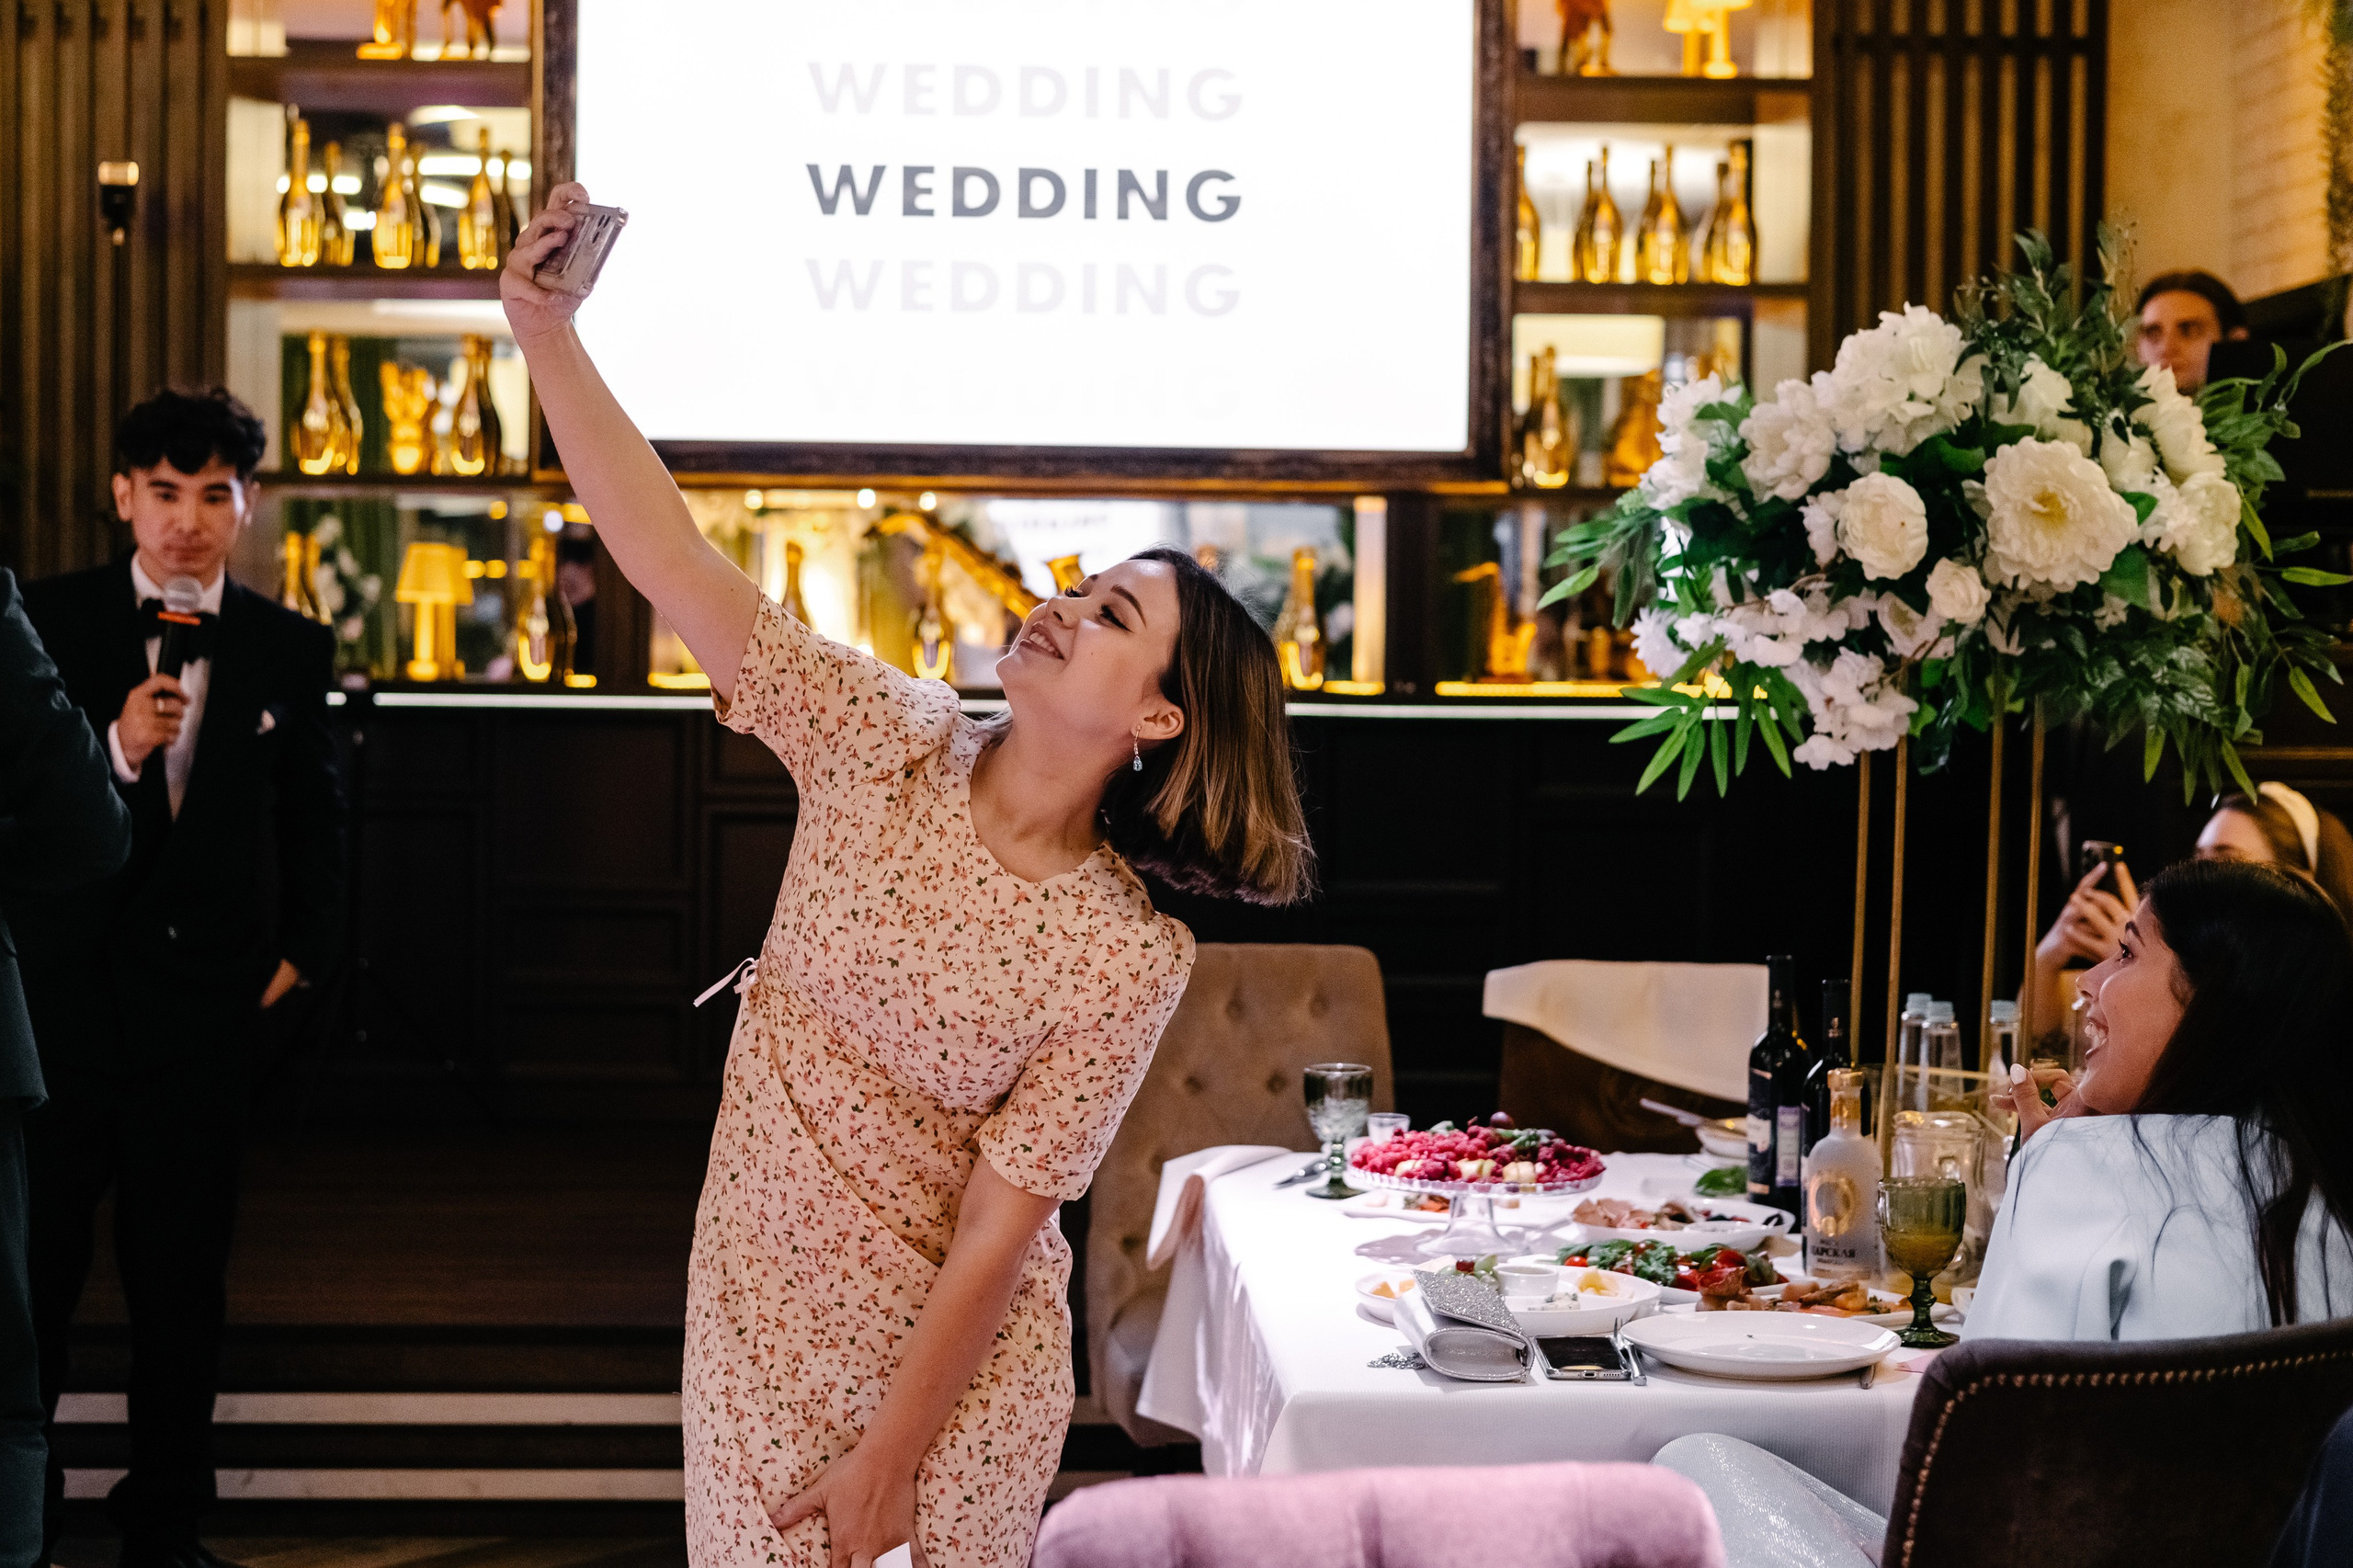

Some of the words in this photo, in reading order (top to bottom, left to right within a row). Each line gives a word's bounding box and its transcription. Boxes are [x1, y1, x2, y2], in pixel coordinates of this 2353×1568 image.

[807, 61, 1243, 121] WEDDING
[806, 163, 1243, 223] WEDDING
[805, 257, 1242, 318] WEDDING
